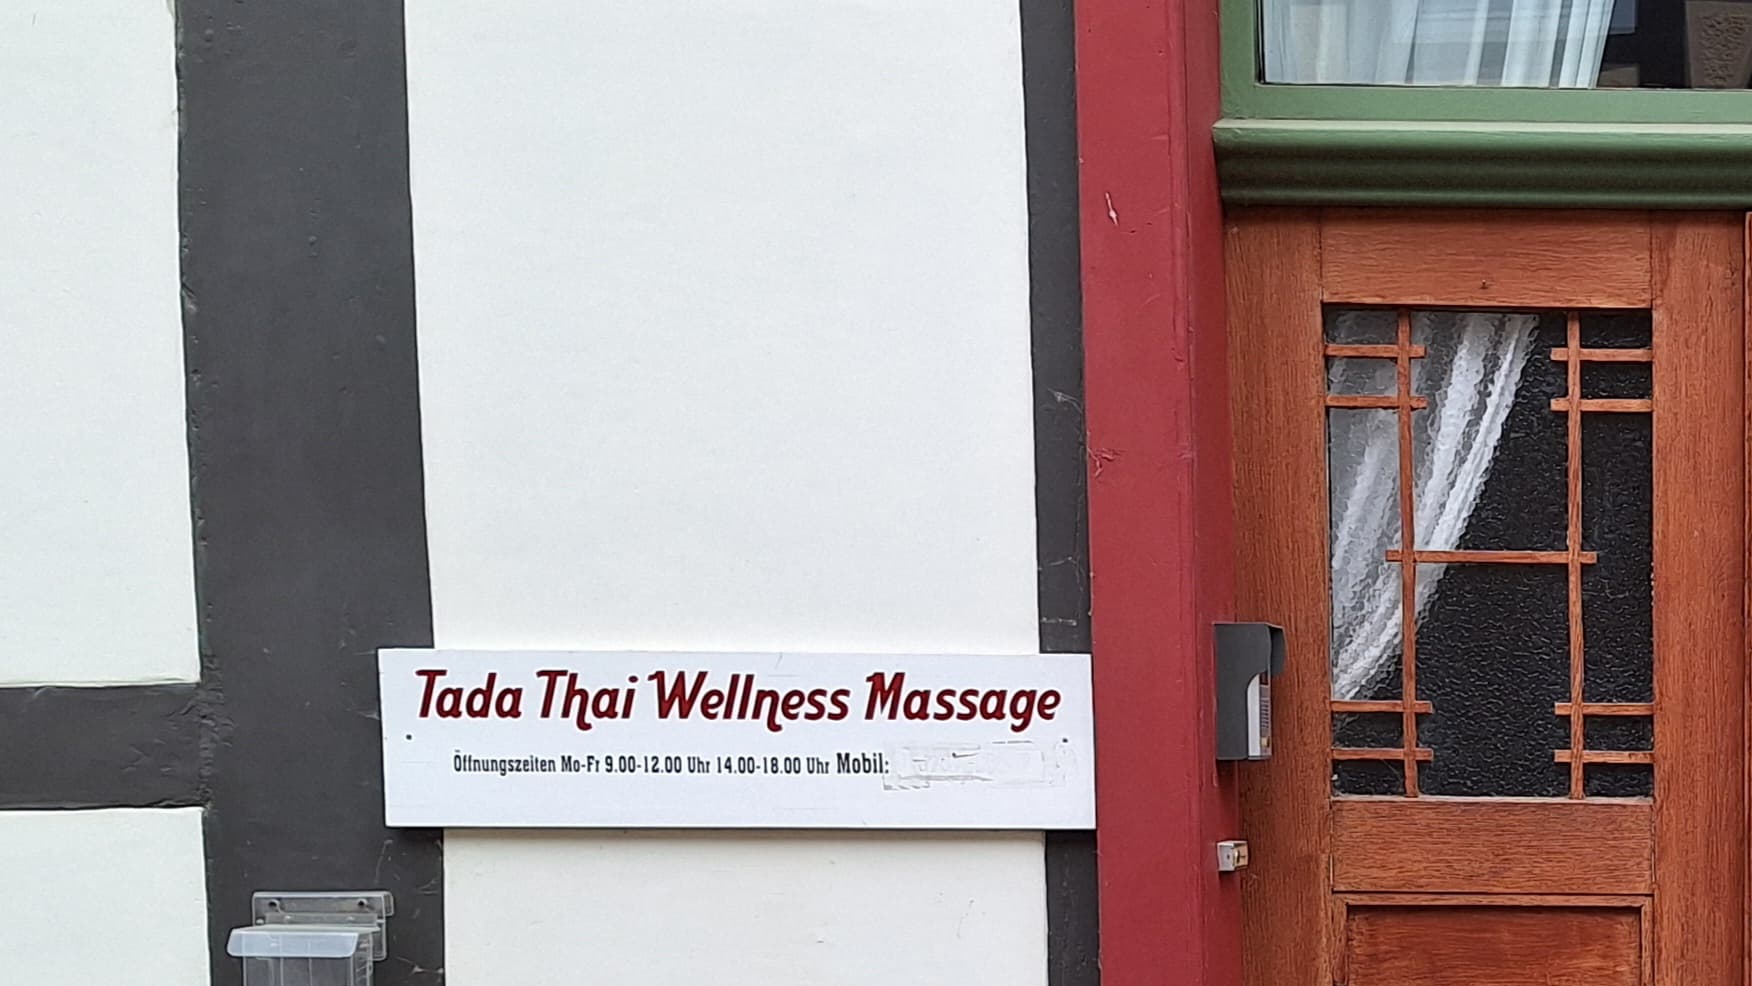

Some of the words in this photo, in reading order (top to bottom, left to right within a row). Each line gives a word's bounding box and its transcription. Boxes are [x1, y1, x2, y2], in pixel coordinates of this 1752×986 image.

[414, 669, 523, 719] Tada
[535, 669, 638, 731] Thai
[647, 670, 851, 732] Wellness
[864, 671, 1061, 732] Massage
[453, 749, 556, 777] Öffnungszeiten
[560, 755, 600, 774] Mo-Fr
[604, 755, 682, 774] 9.00-12.00
[686, 756, 710, 774] Uhr
[716, 756, 801, 775] 14.00-18.00
[806, 756, 830, 774] Uhr
[836, 752, 889, 774] Mobil:
